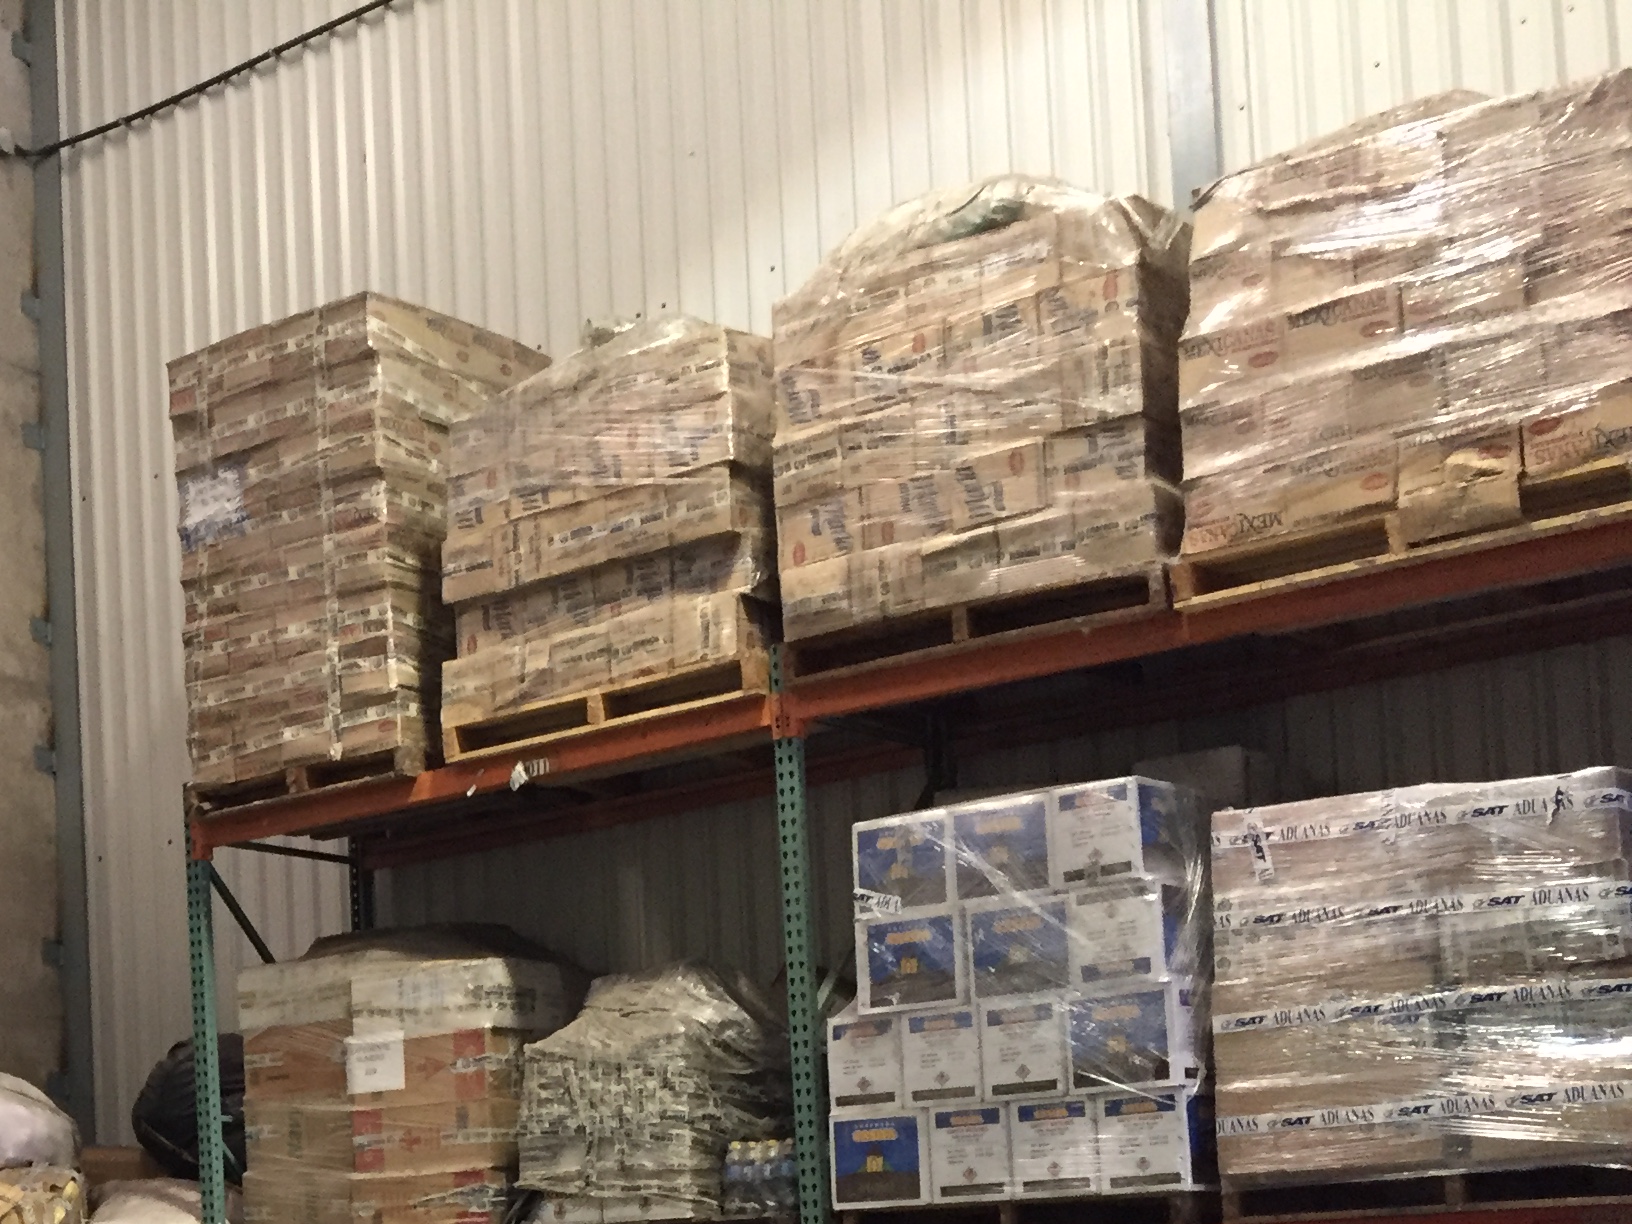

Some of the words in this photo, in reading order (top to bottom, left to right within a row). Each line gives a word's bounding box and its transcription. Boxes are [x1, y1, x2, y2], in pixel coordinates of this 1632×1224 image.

[1279, 824, 1331, 841] ADUANAS
[1470, 804, 1509, 818] SAT
[1253, 914, 1285, 925] SAT
[1369, 904, 1403, 916] SAT
[1487, 895, 1526, 908] SAT
[1532, 885, 1590, 906] ADUANAS
[1235, 1014, 1267, 1027] SAT
[1272, 1007, 1326, 1026] ADUANAS
[1350, 1003, 1385, 1015] SAT
[1389, 995, 1447, 1016] ADUANAS
[1471, 991, 1507, 1003] SAT
[1513, 985, 1572, 1003] ADUANAS
[1281, 1115, 1315, 1127] SAT
[1320, 1108, 1374, 1128] ADUANAS
[1397, 1104, 1433, 1116] SAT
[1439, 1097, 1495, 1117] ADUANAS
[1520, 1091, 1558, 1103] SAT
[1563, 1082, 1625, 1106] ADUANAS
